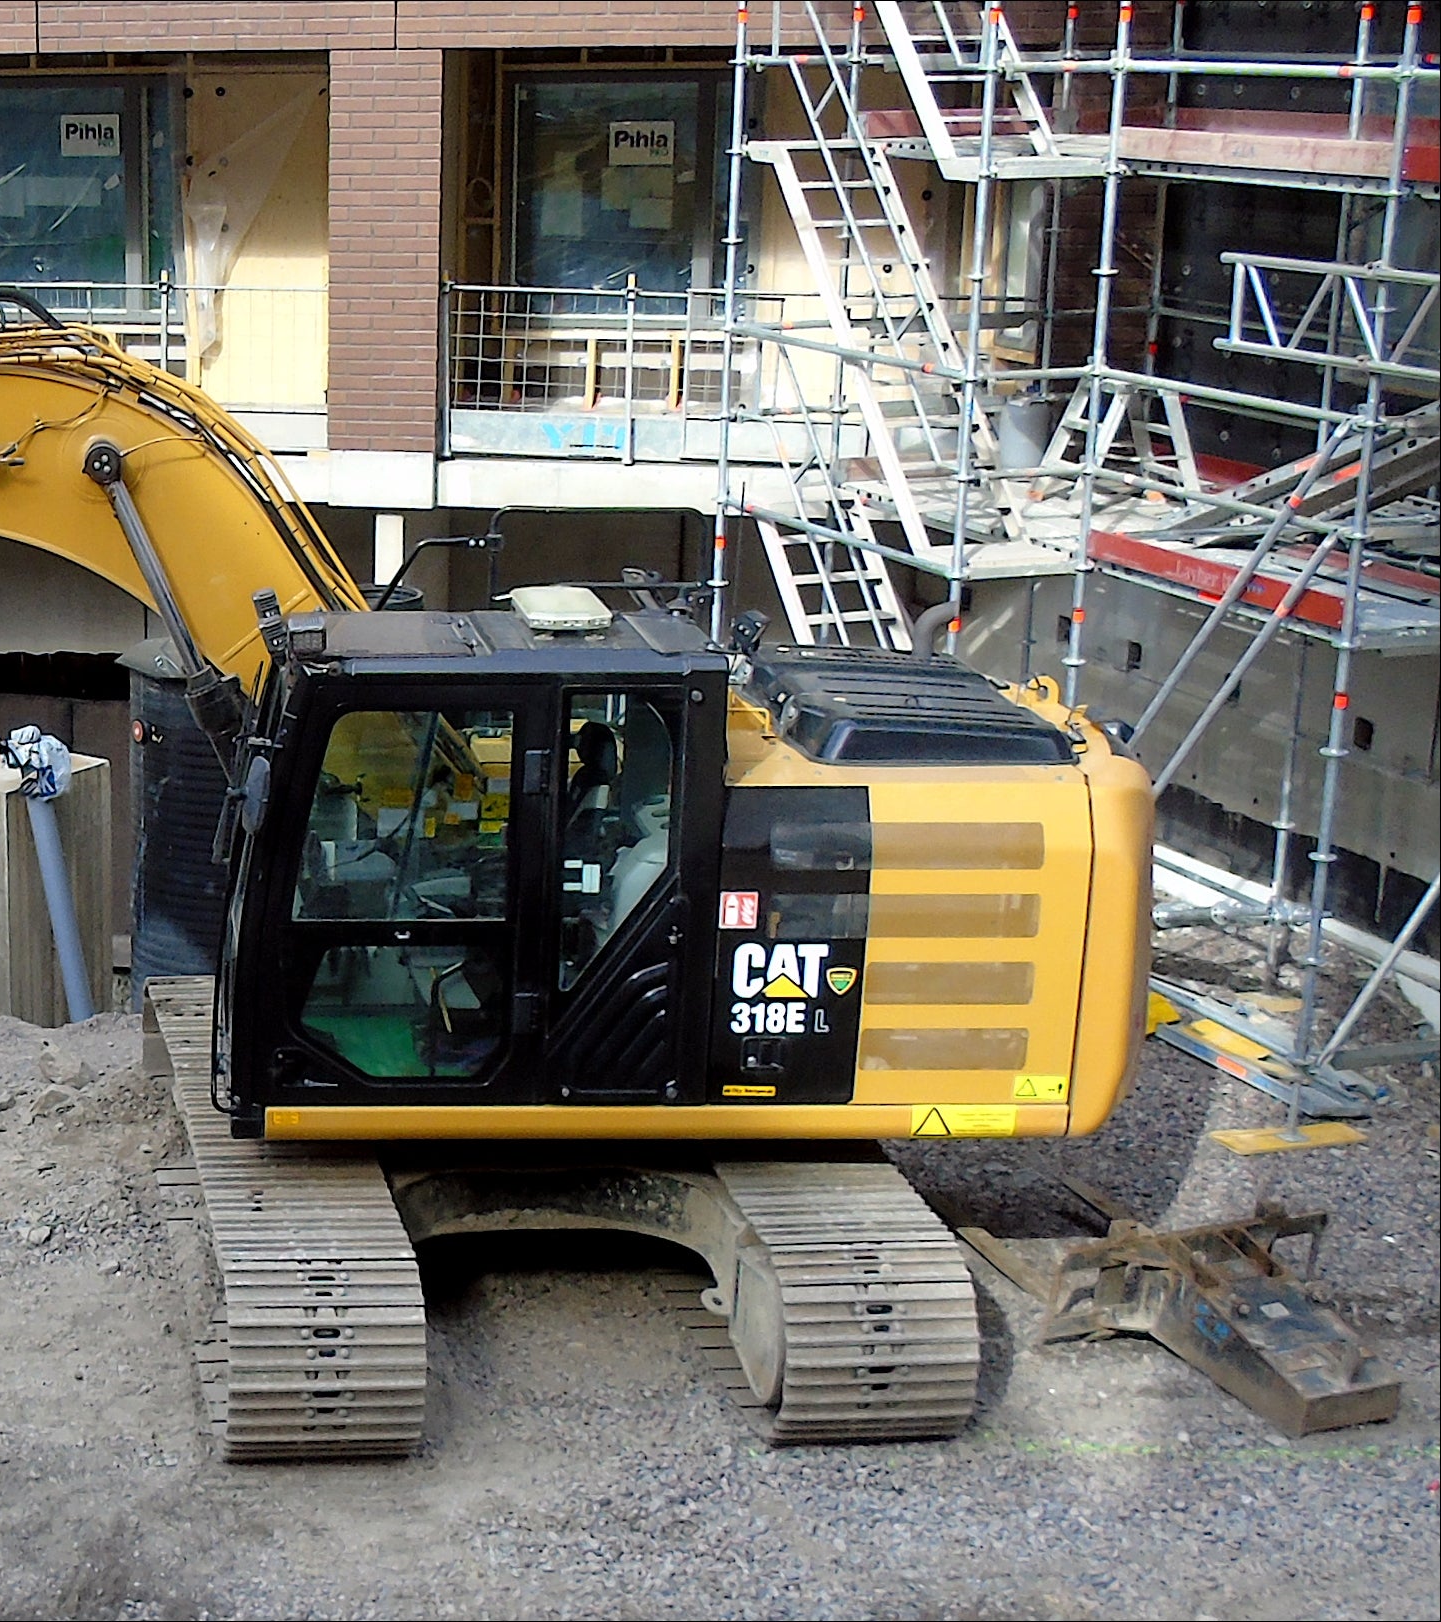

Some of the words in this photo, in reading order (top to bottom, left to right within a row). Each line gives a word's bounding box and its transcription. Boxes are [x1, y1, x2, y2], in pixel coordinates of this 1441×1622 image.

[65, 122, 114, 140] Pihla
[614, 129, 668, 148] Pihla
[732, 942, 830, 999] CAT
[730, 1002, 807, 1034] 318E
[813, 1008, 830, 1033] L
